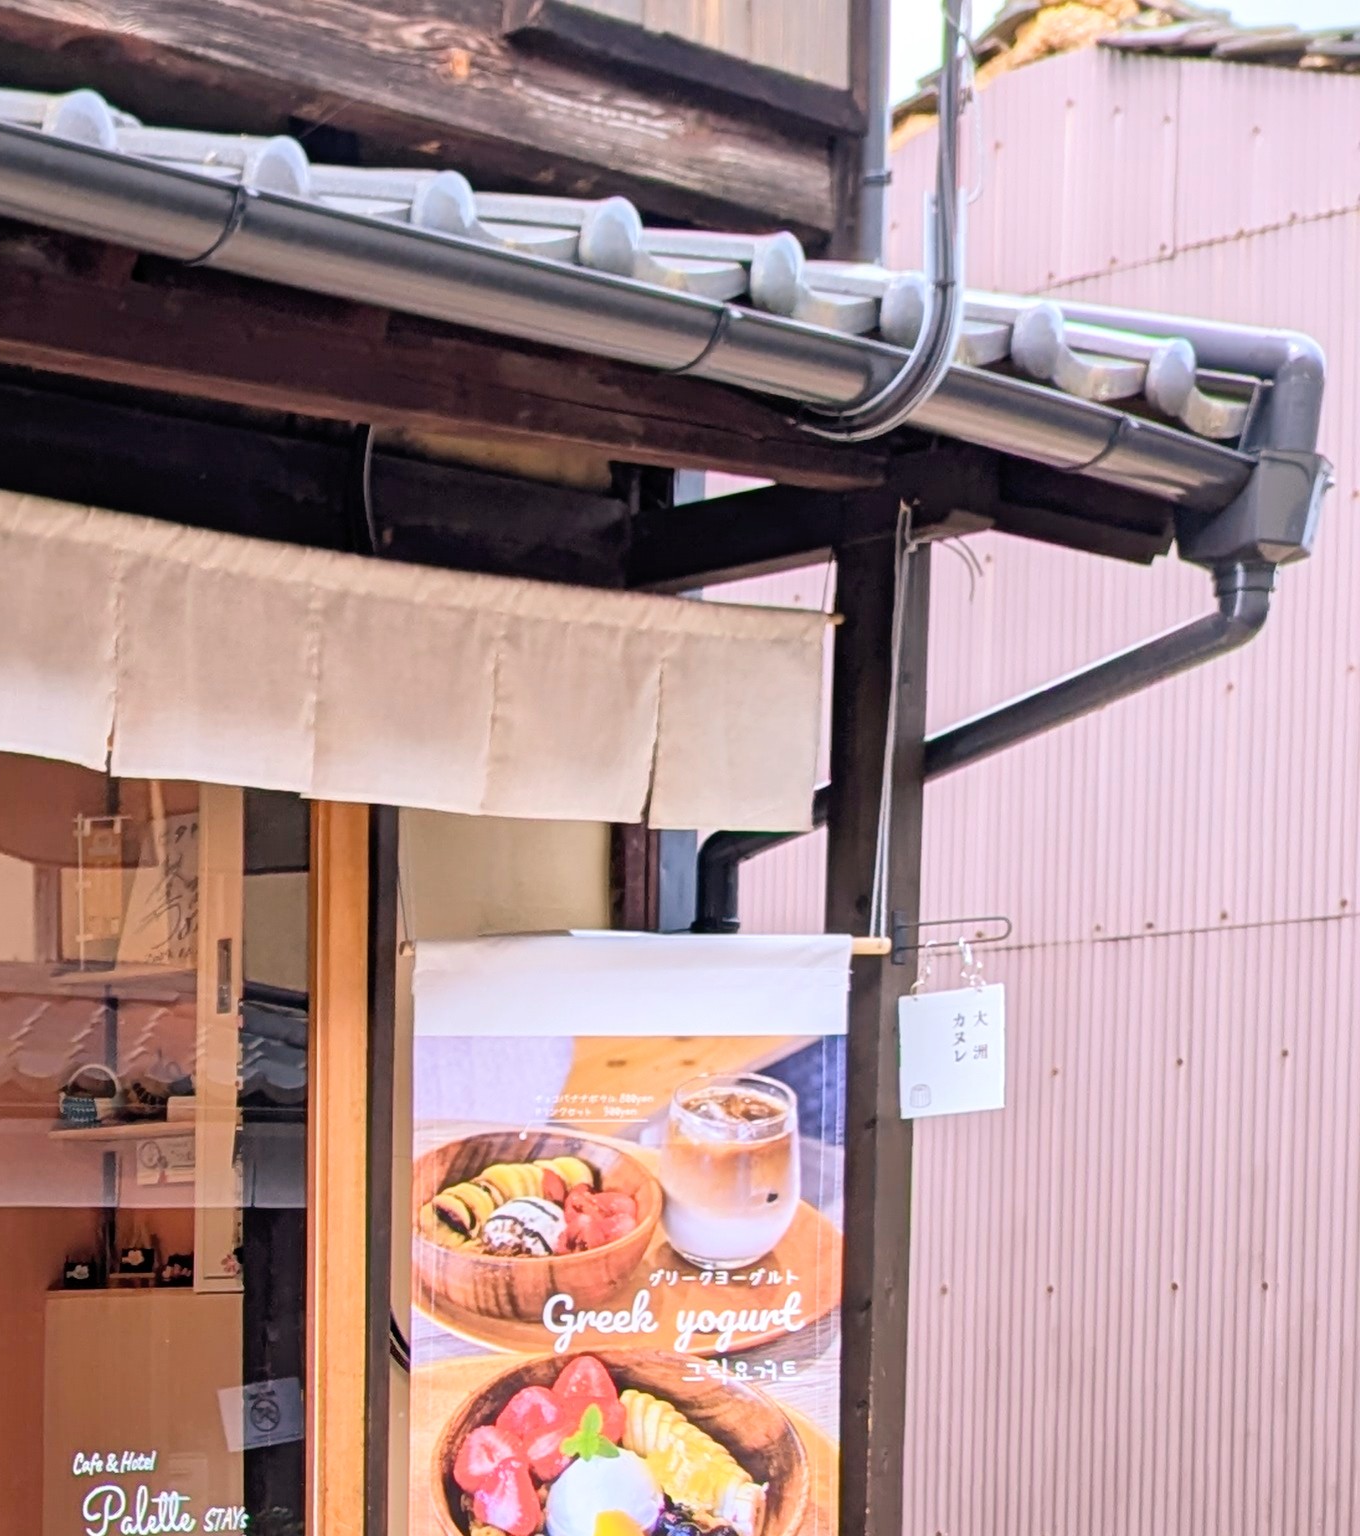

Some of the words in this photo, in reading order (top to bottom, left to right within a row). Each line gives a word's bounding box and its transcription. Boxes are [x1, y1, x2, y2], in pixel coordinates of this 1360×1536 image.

[952, 1013, 967, 1062] カヌレ
[973, 1010, 988, 1060] 大洲
[649, 1269, 799, 1287] グリークヨーグルト
[542, 1289, 659, 1353] Greek
[674, 1290, 806, 1353] yogurt
[682, 1359, 803, 1385] 그릭요거트
[73, 1452, 103, 1475] Cafe
[105, 1453, 119, 1473] &
[120, 1450, 157, 1473] Hotel
